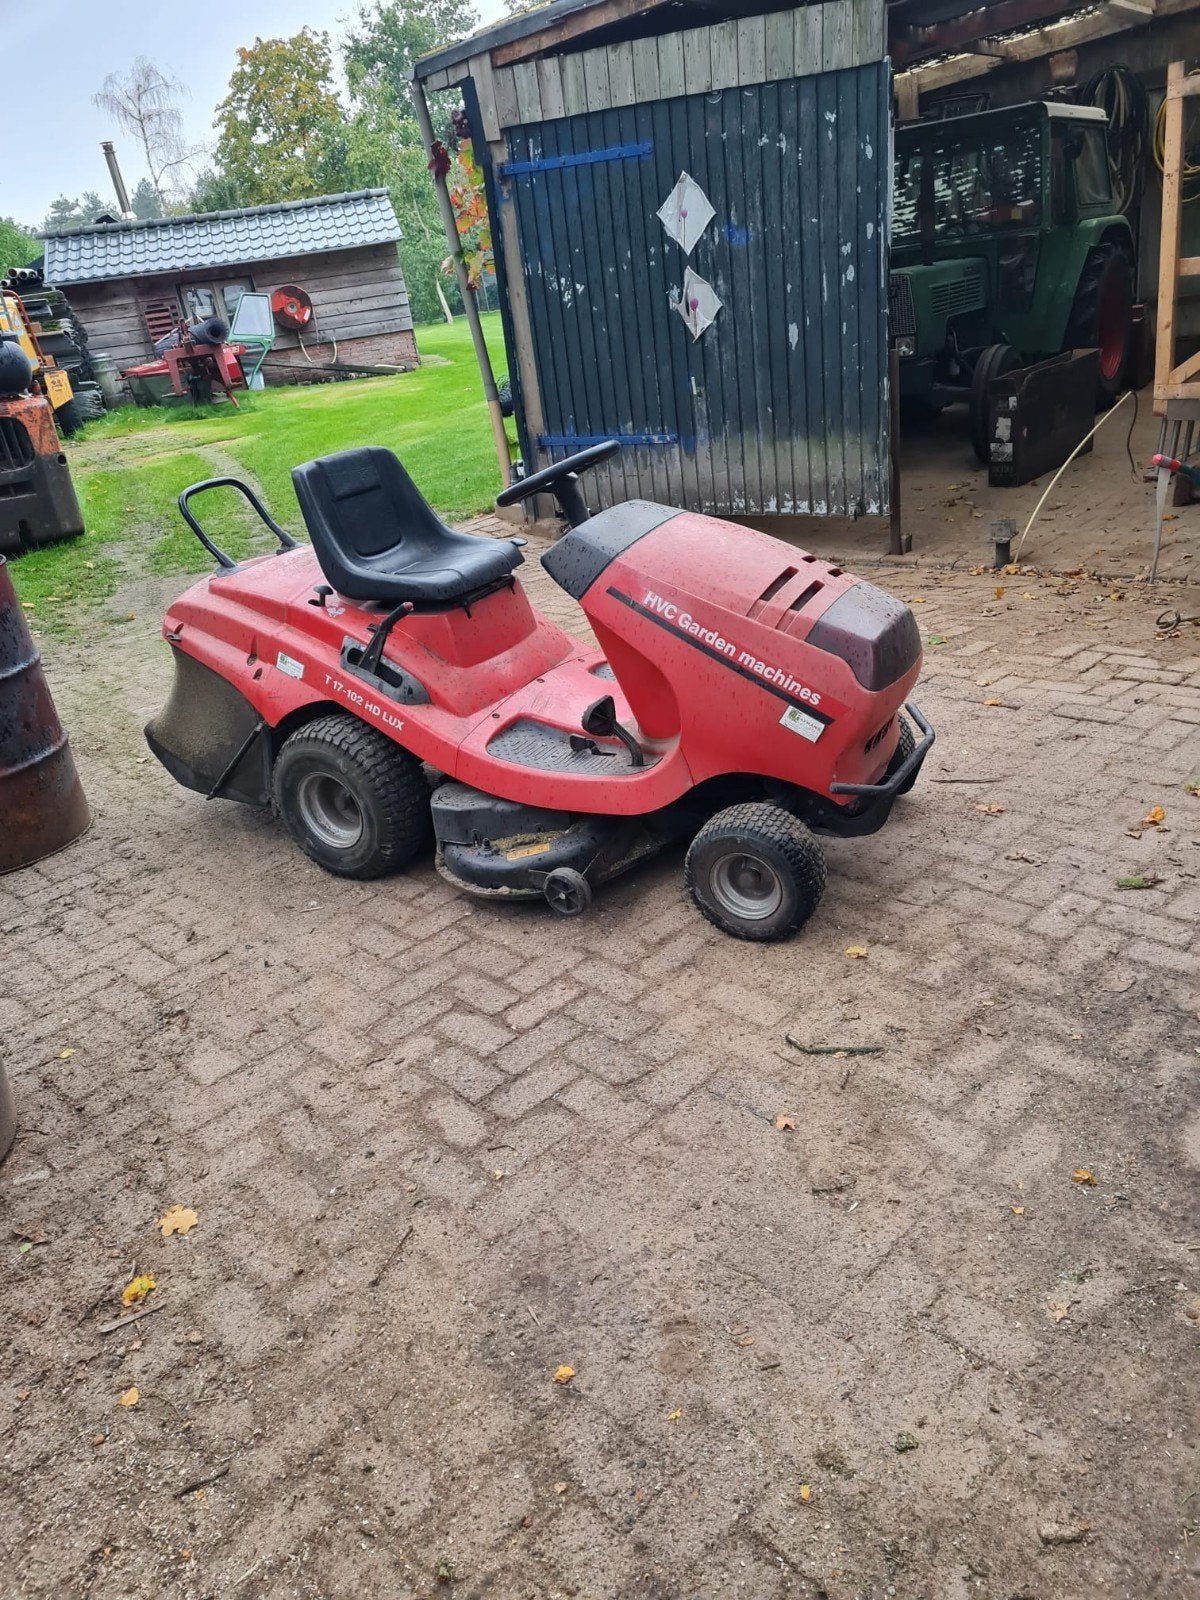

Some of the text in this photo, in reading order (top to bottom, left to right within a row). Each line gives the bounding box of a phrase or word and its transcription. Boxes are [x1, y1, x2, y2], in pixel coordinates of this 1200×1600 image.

[643, 591, 822, 706] HVC Garden machines
[325, 674, 404, 731] T 17-102 HD LUX
